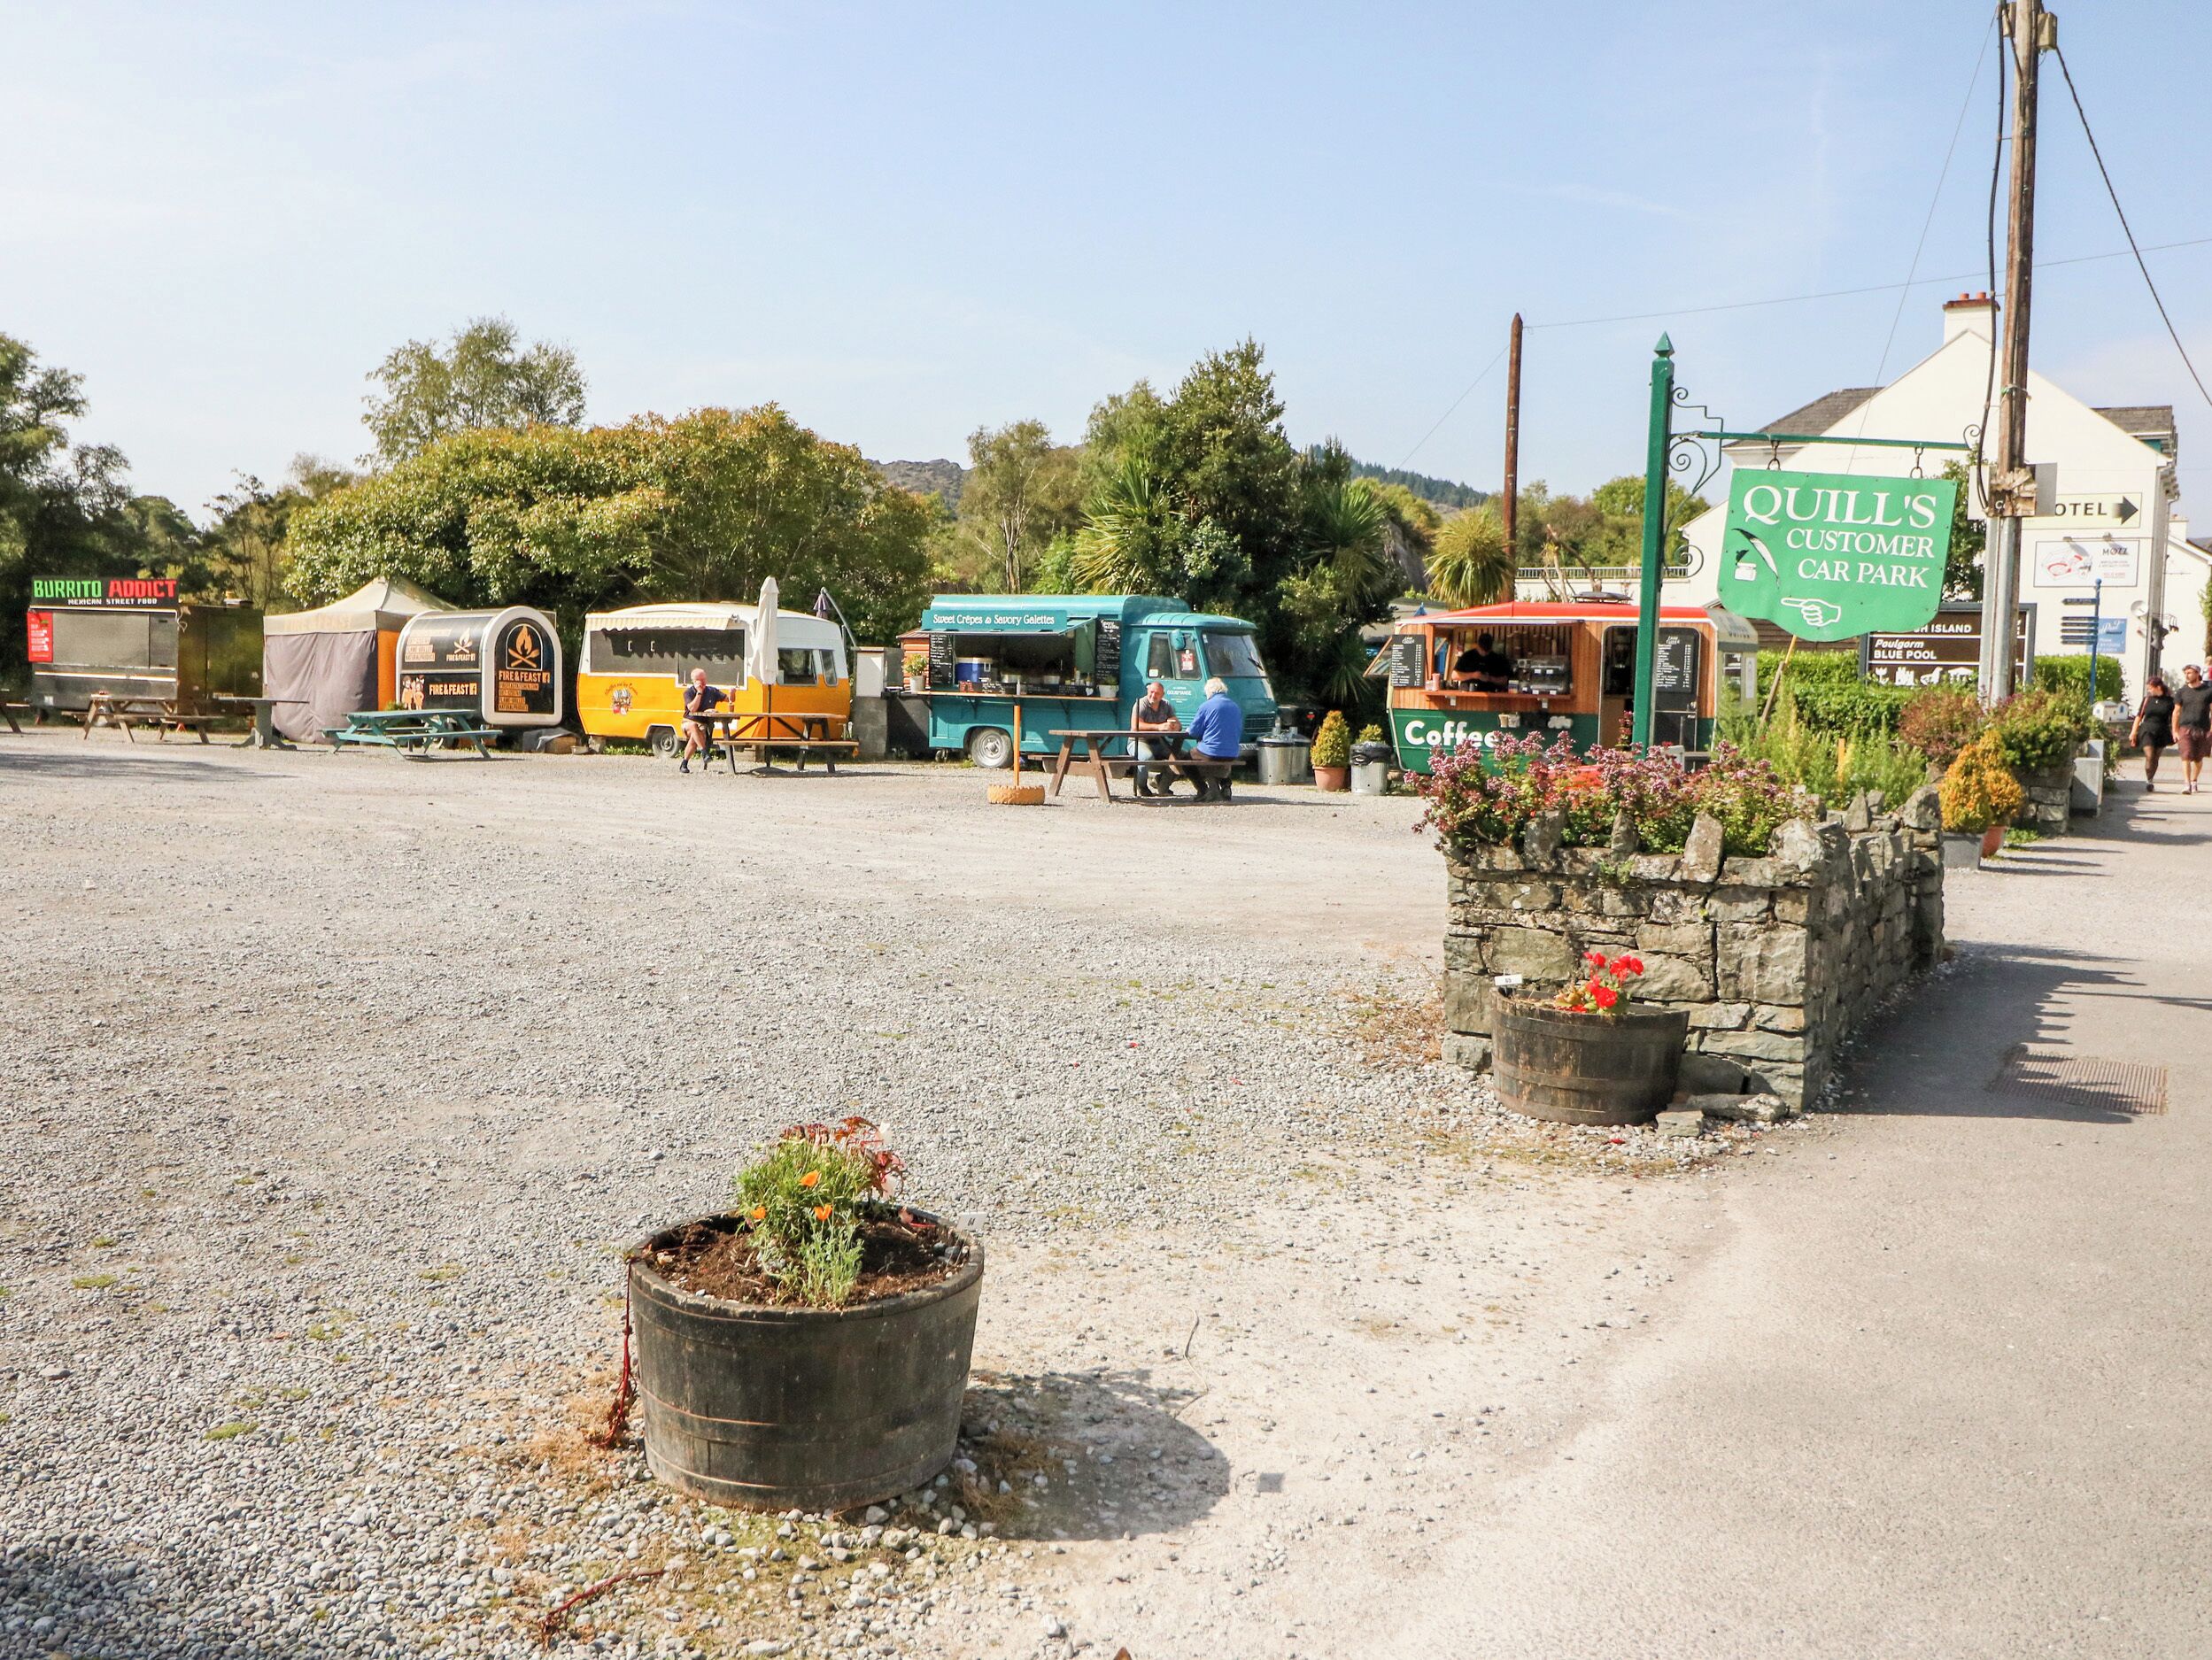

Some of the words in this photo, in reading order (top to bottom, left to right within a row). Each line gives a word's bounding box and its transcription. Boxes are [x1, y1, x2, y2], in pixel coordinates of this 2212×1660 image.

[1743, 485, 1937, 529] QUILL'S
[2053, 502, 2108, 516] OTEL
[1786, 528, 1935, 559] CUSTOMER
[1798, 559, 1850, 582] CAR
[1856, 562, 1930, 589] PARK
[33, 580, 102, 598] BURRITO
[108, 580, 177, 598] ADDICT
[932, 614, 955, 624] Sweet
[956, 614, 983, 625] Crêpes
[994, 614, 1023, 626] Savory
[1023, 614, 1055, 625] Galettes
[1930, 624, 1972, 634] ISLAND
[1875, 639, 1925, 649] Poulgorm
[1874, 650, 1903, 660] BLUE
[1906, 650, 1937, 660] POOL
[1404, 720, 1501, 748] Coffee
